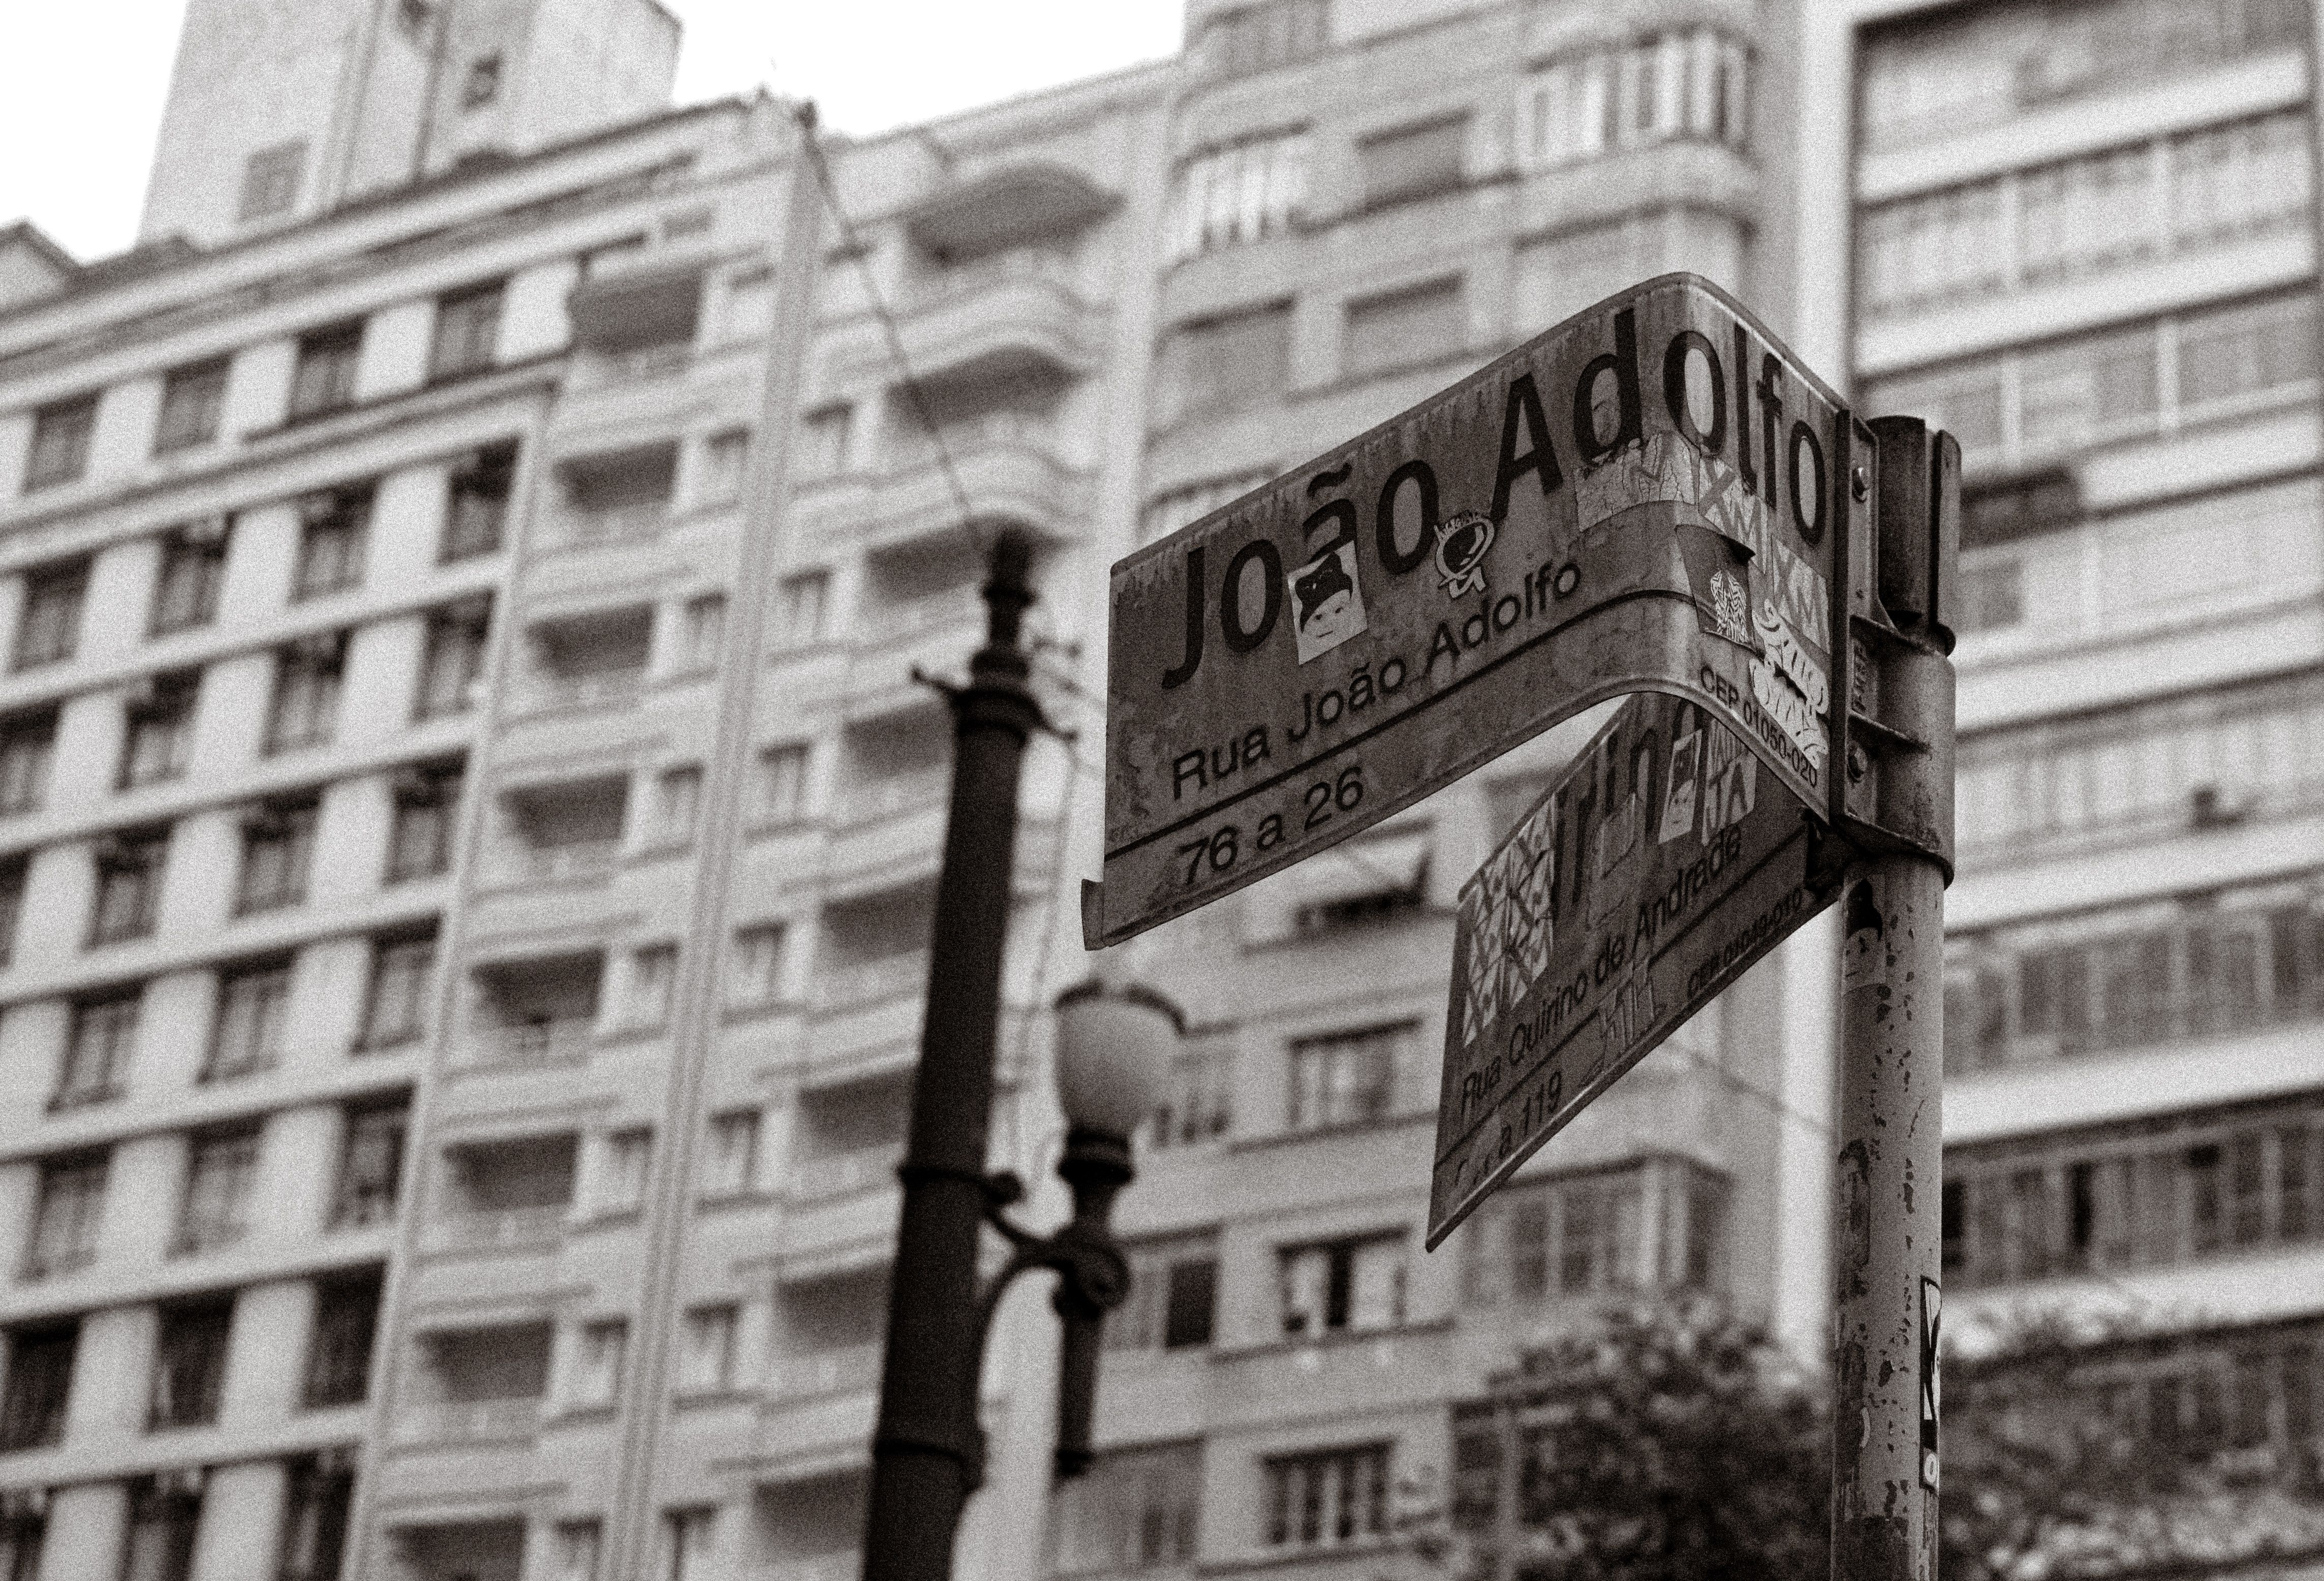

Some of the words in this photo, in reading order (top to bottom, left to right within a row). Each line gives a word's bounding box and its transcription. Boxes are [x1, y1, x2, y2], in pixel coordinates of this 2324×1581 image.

[1491, 306, 1827, 545] Adolfo
[1172, 725, 1271, 801] Rua
[1286, 656, 1406, 743] João
[1427, 560, 1582, 676] Adolfo
[1700, 667, 1738, 708] CEP
[1741, 700, 1817, 788] 01050-020
[1179, 825, 1237, 885] 76
[1256, 813, 1285, 850] a
[1304, 767, 1365, 832] 26
[1462, 1051, 1502, 1118] Rua
[1508, 978, 1589, 1063] Quirino
[1594, 938, 1625, 987] de
[1634, 824, 1743, 955] Andrade
[1521, 1070, 1563, 1136] 119
